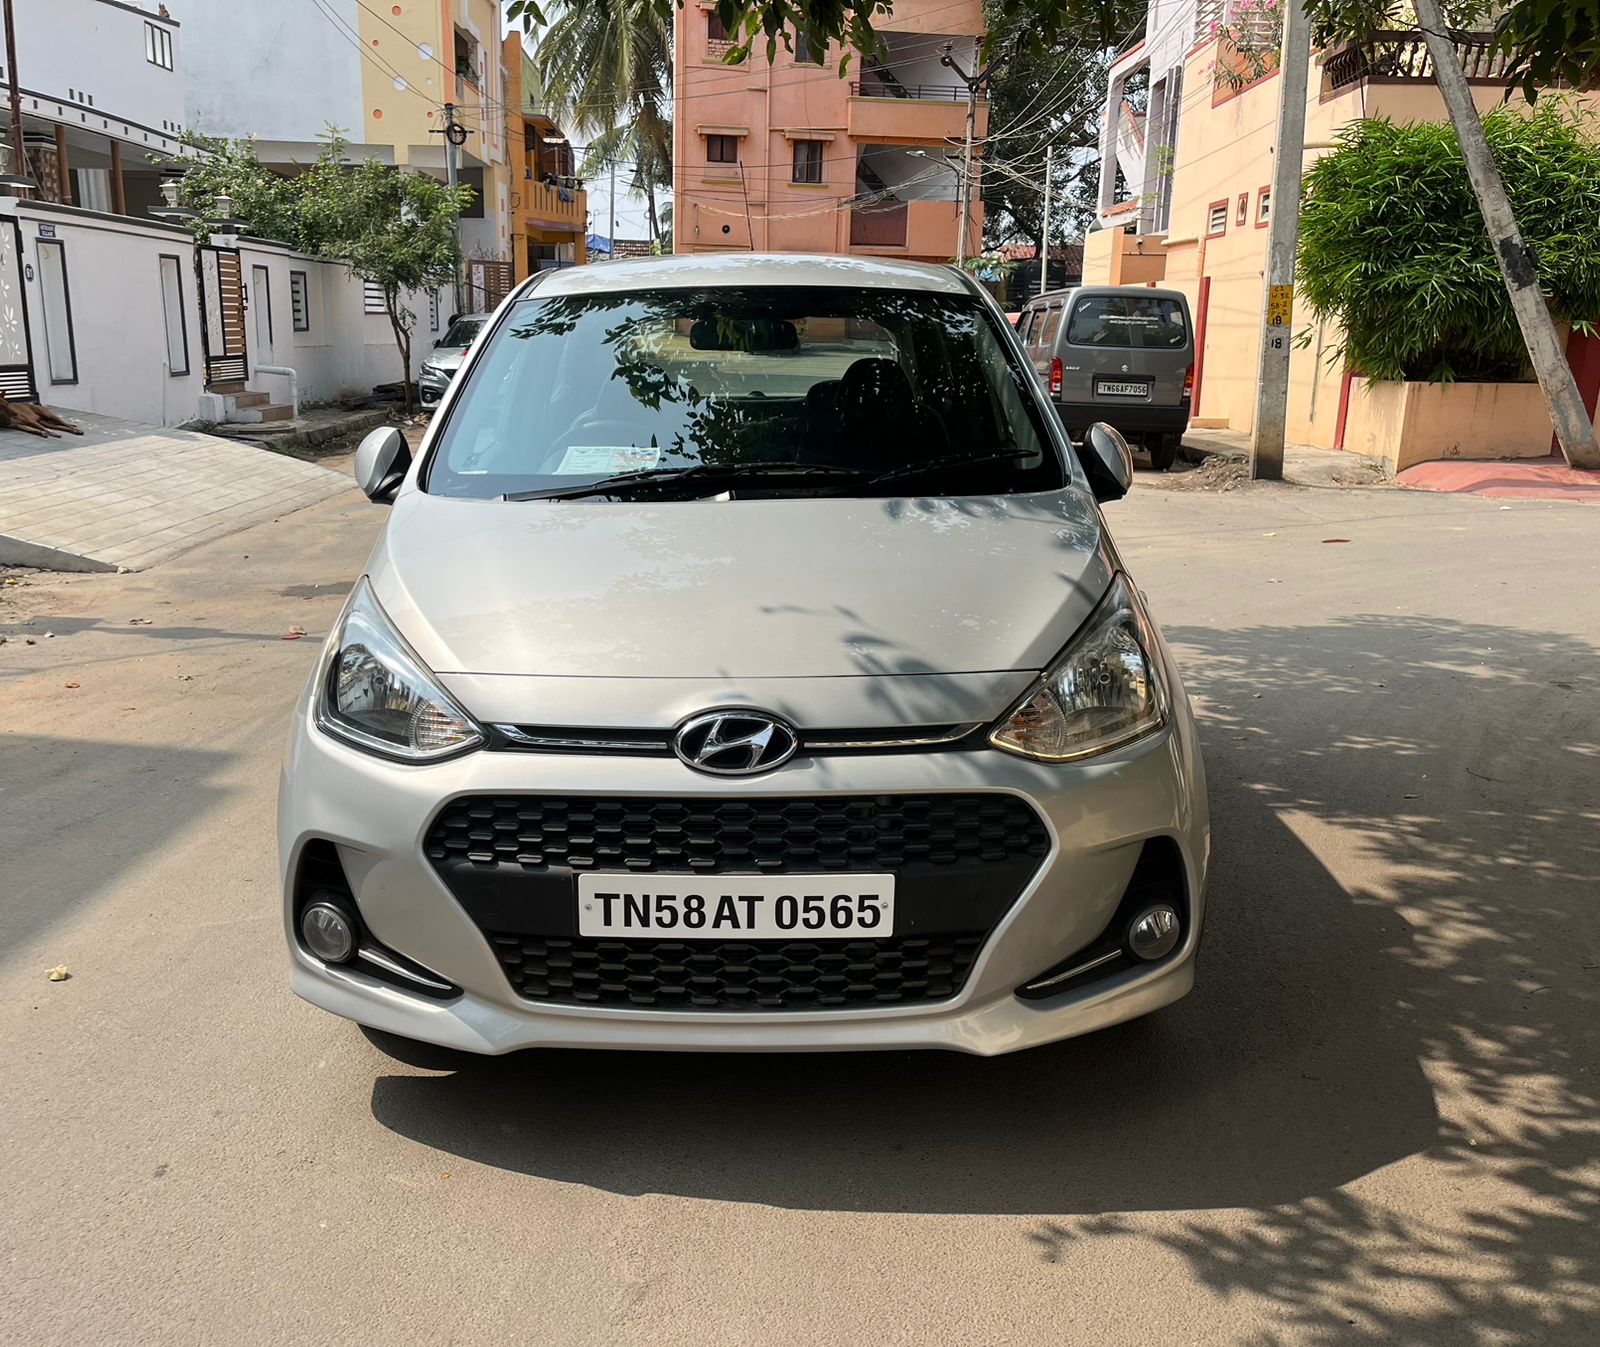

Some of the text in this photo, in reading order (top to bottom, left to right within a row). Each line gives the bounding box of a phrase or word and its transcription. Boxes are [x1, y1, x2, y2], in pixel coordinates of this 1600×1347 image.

[1272, 315, 1282, 326] 18
[1271, 338, 1282, 349] 18
[774, 894, 881, 930] 0565
